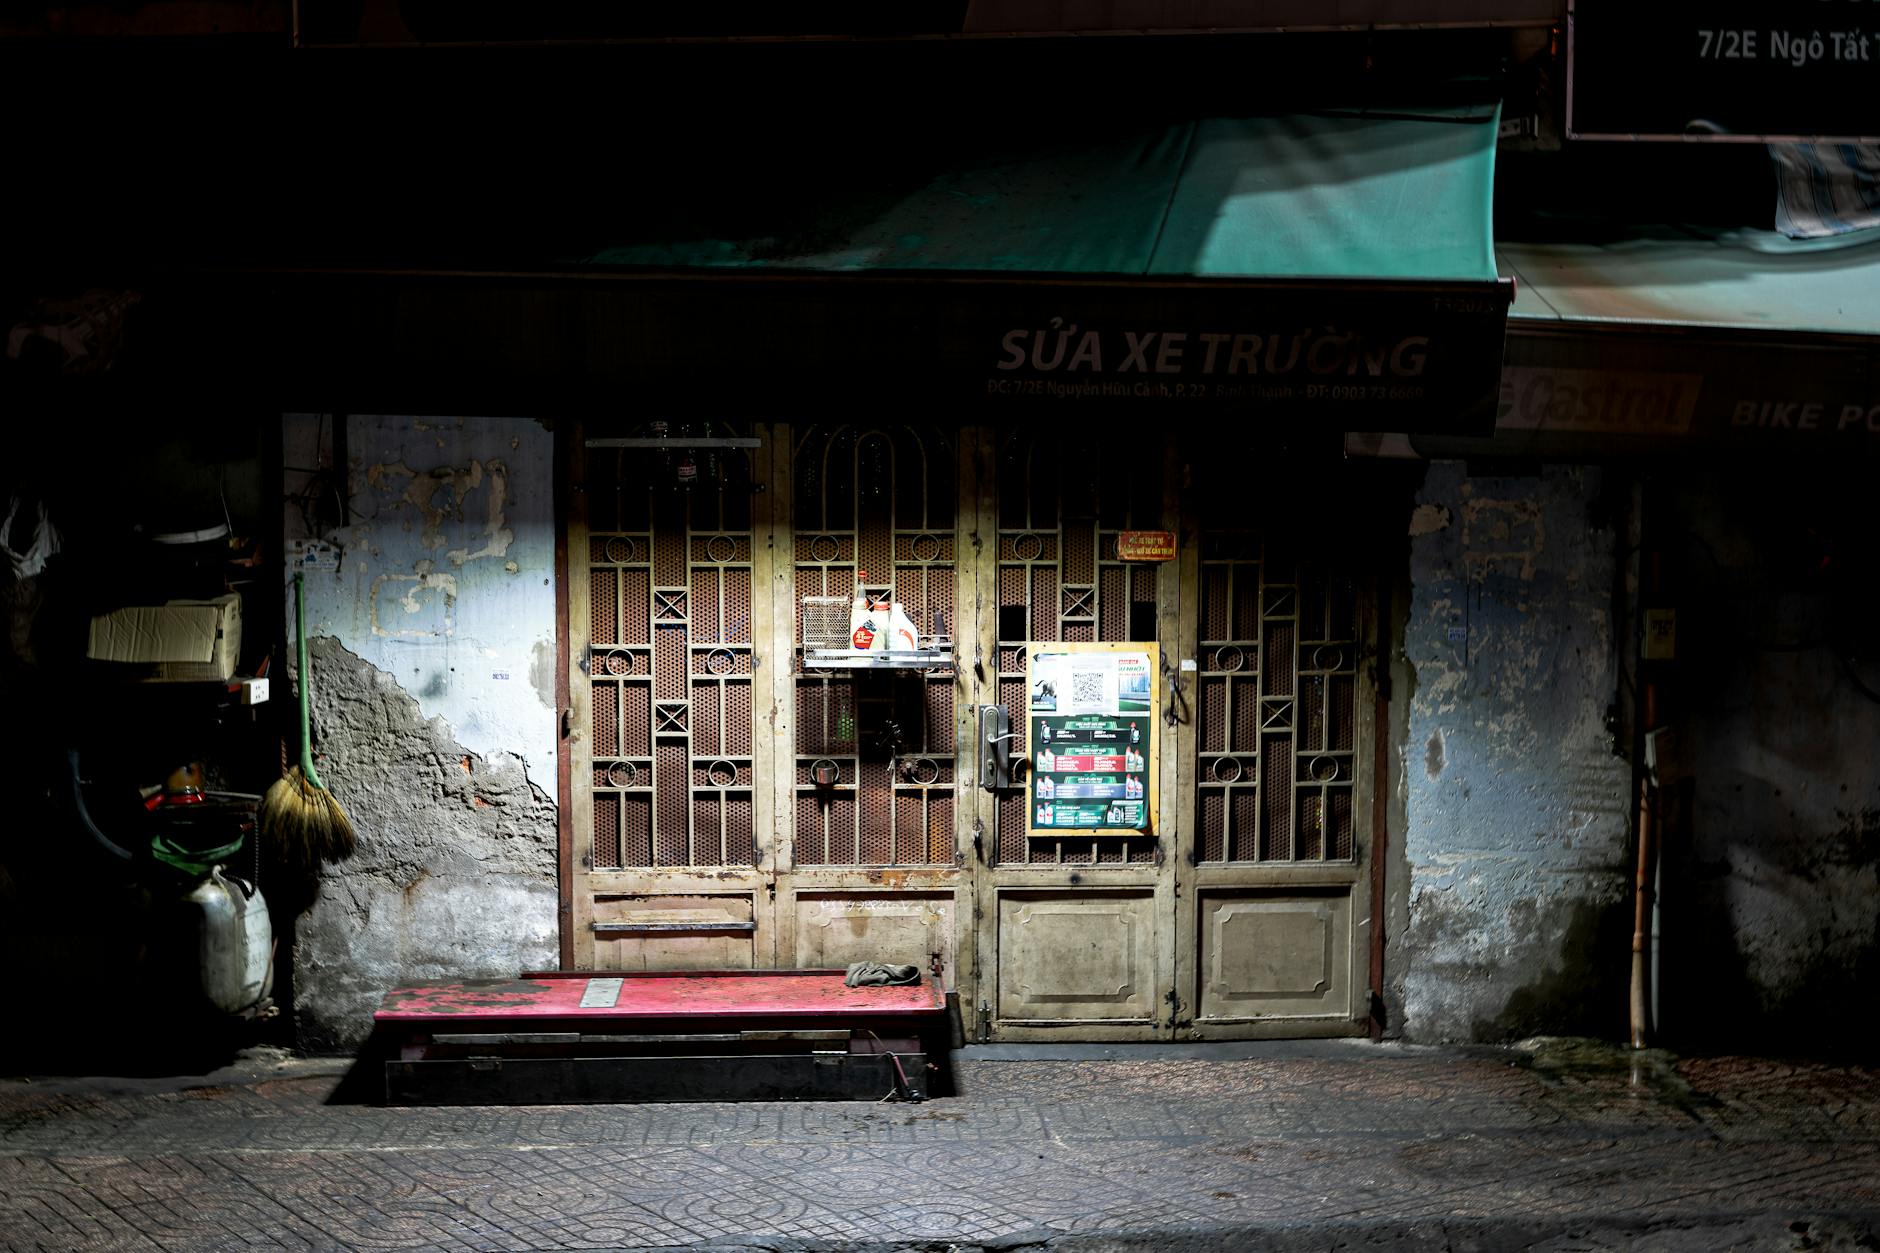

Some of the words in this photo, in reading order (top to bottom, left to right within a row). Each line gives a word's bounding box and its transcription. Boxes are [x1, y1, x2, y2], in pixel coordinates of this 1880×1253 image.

[1698, 29, 1758, 60] 7/2E
[1769, 29, 1825, 67] Ngô
[1829, 27, 1870, 61] Tất
[996, 316, 1103, 372] SỬA
[1117, 331, 1188, 374] XE
[1199, 324, 1431, 377] TRƯỜNG
[1519, 373, 1686, 426] Castrol
[1731, 400, 1825, 429] BIKE
